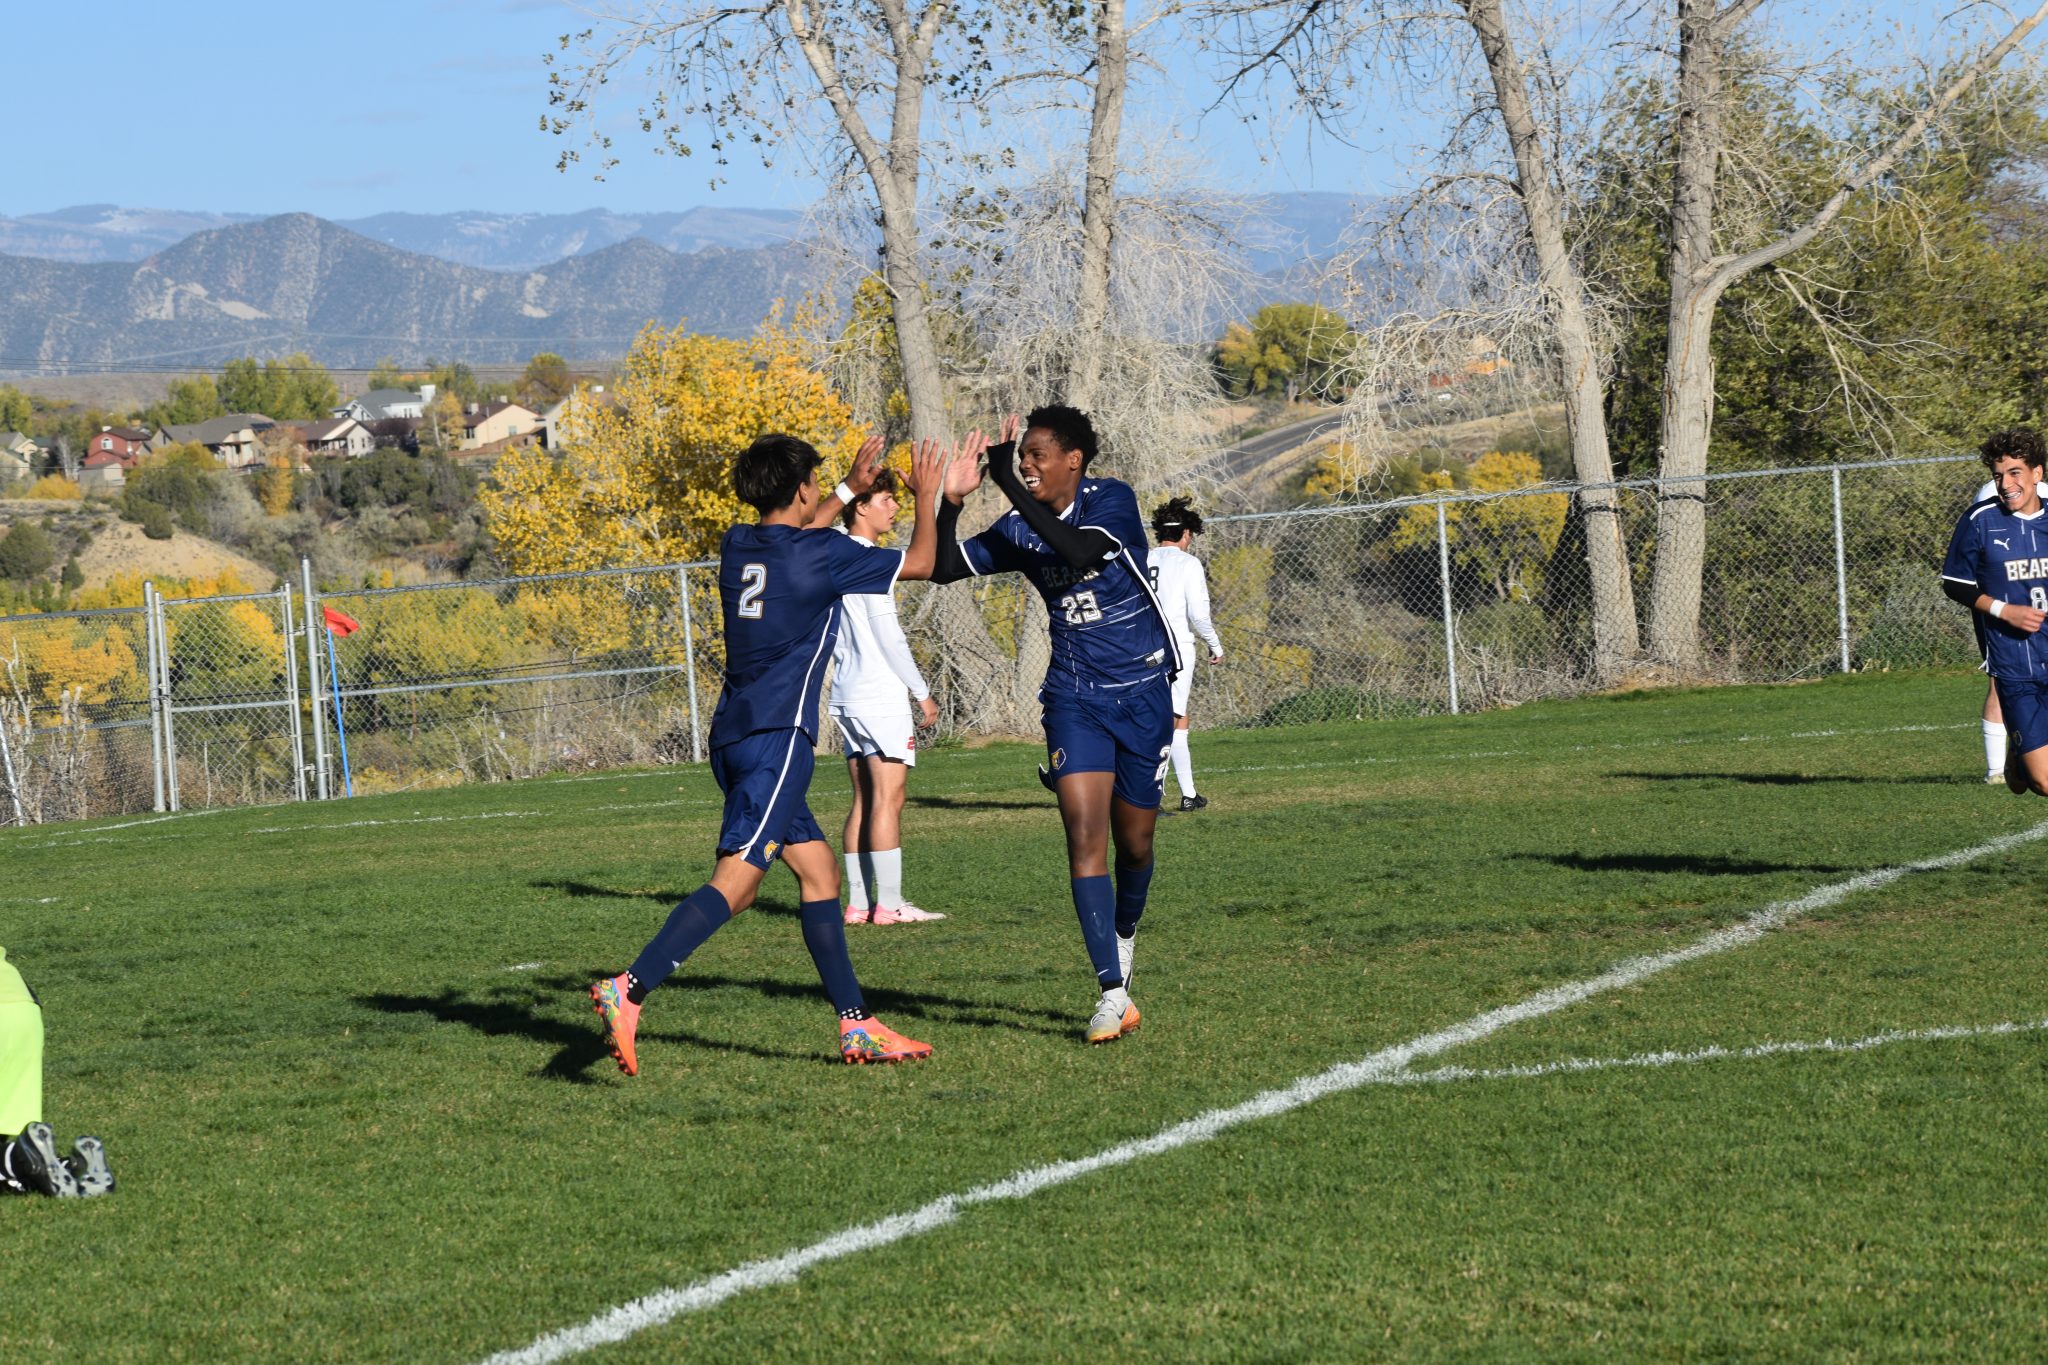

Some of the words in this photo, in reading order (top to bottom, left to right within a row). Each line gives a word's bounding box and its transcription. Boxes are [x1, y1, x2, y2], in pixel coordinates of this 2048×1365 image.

[2004, 557, 2048, 581] BEAR
[738, 563, 767, 618] 2
[2030, 586, 2048, 613] 8
[1060, 590, 1103, 625] 23
